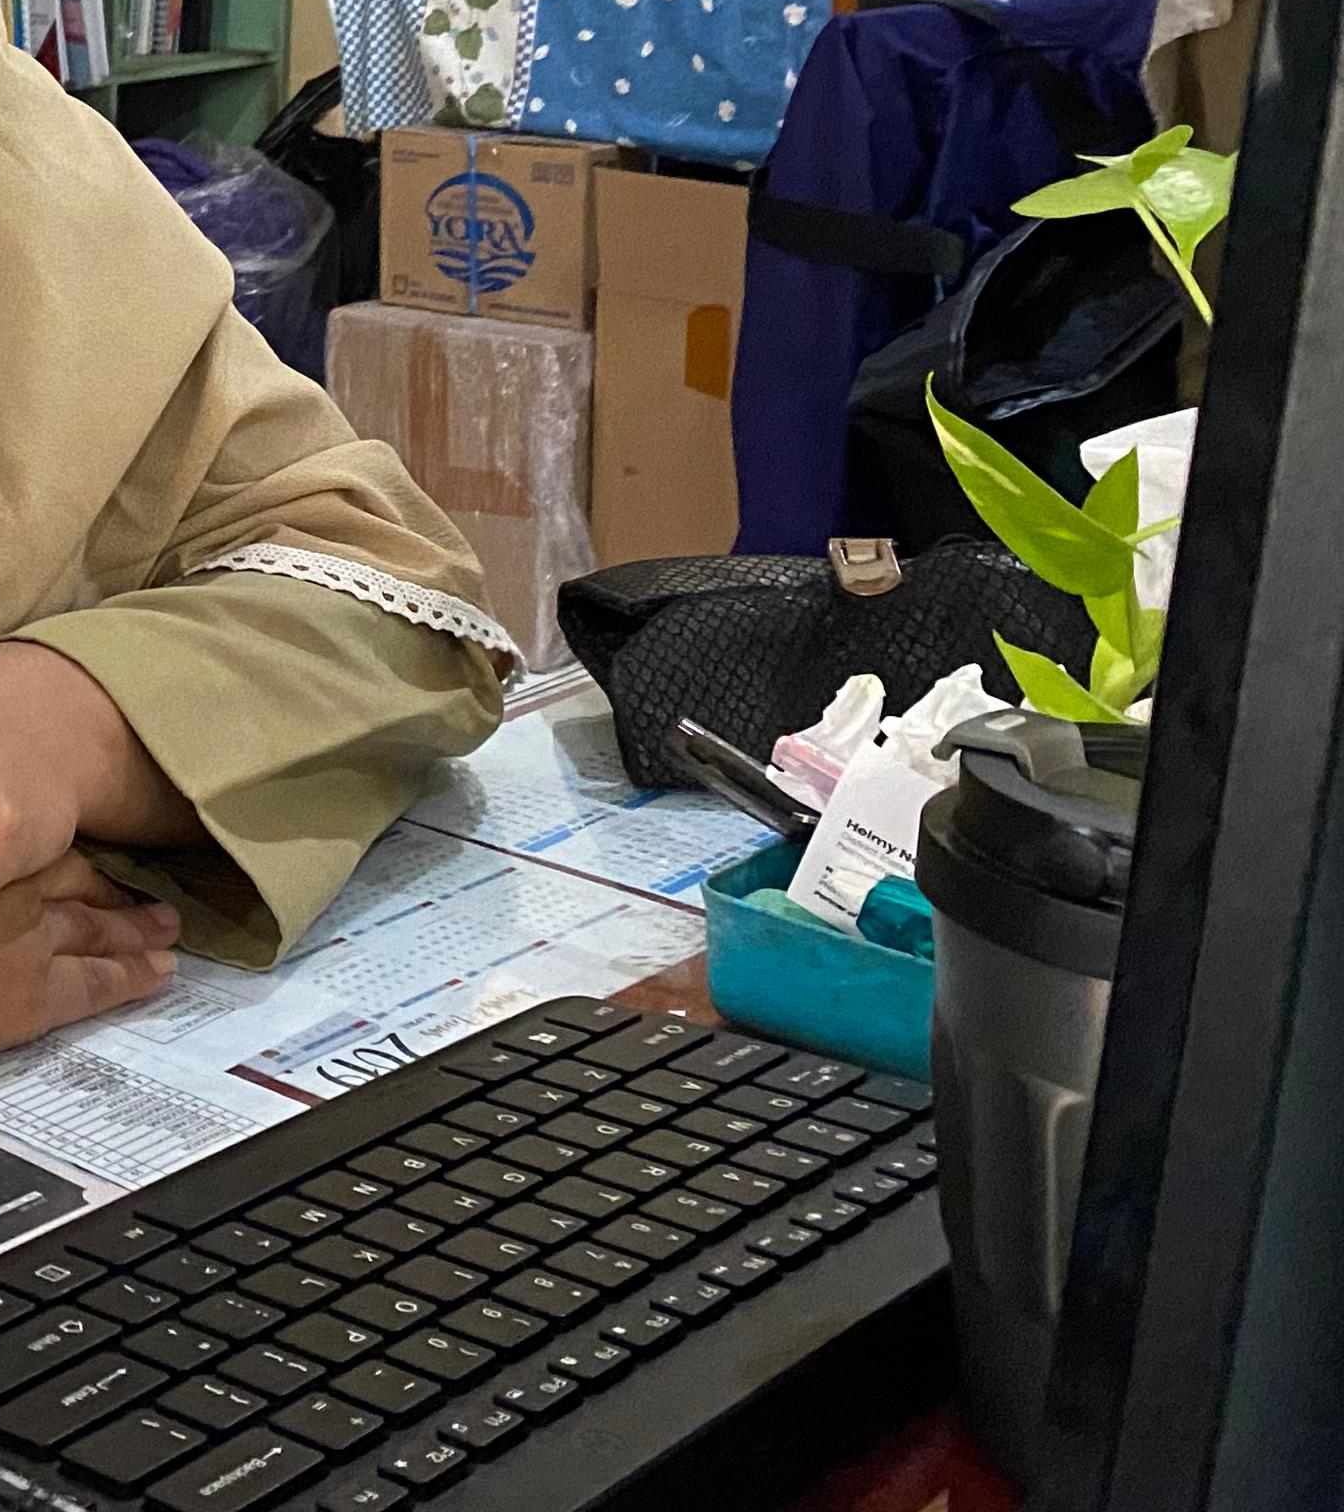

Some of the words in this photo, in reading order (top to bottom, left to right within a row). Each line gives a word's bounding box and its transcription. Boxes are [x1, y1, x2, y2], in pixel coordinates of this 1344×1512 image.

[846, 819, 897, 855] Helmy
[584, 1071, 606, 1079] Z
[541, 1092, 562, 1100] X
[769, 1099, 792, 1107] Q
[641, 1104, 662, 1112] S
[597, 1125, 619, 1134] D
[727, 1121, 752, 1131] W
[688, 1143, 710, 1151] E
[558, 1148, 573, 1156] F
[404, 1159, 425, 1168] B
[642, 1166, 666, 1176] R
[503, 1173, 525, 1182] G
[353, 1183, 377, 1194] N
[600, 1193, 620, 1201] T
[678, 1197, 697, 1205] 5
[455, 1197, 478, 1207] H
[301, 1210, 326, 1222] M
[408, 1223, 424, 1233] J
[551, 1219, 572, 1228] Y
[500, 1244, 523, 1254] U
[354, 1251, 378, 1261] K
[587, 1251, 604, 1259] 7
[535, 1278, 553, 1287] 8
[395, 1302, 417, 1312] O
[483, 1309, 501, 1317] 9
[348, 1330, 366, 1342] P
